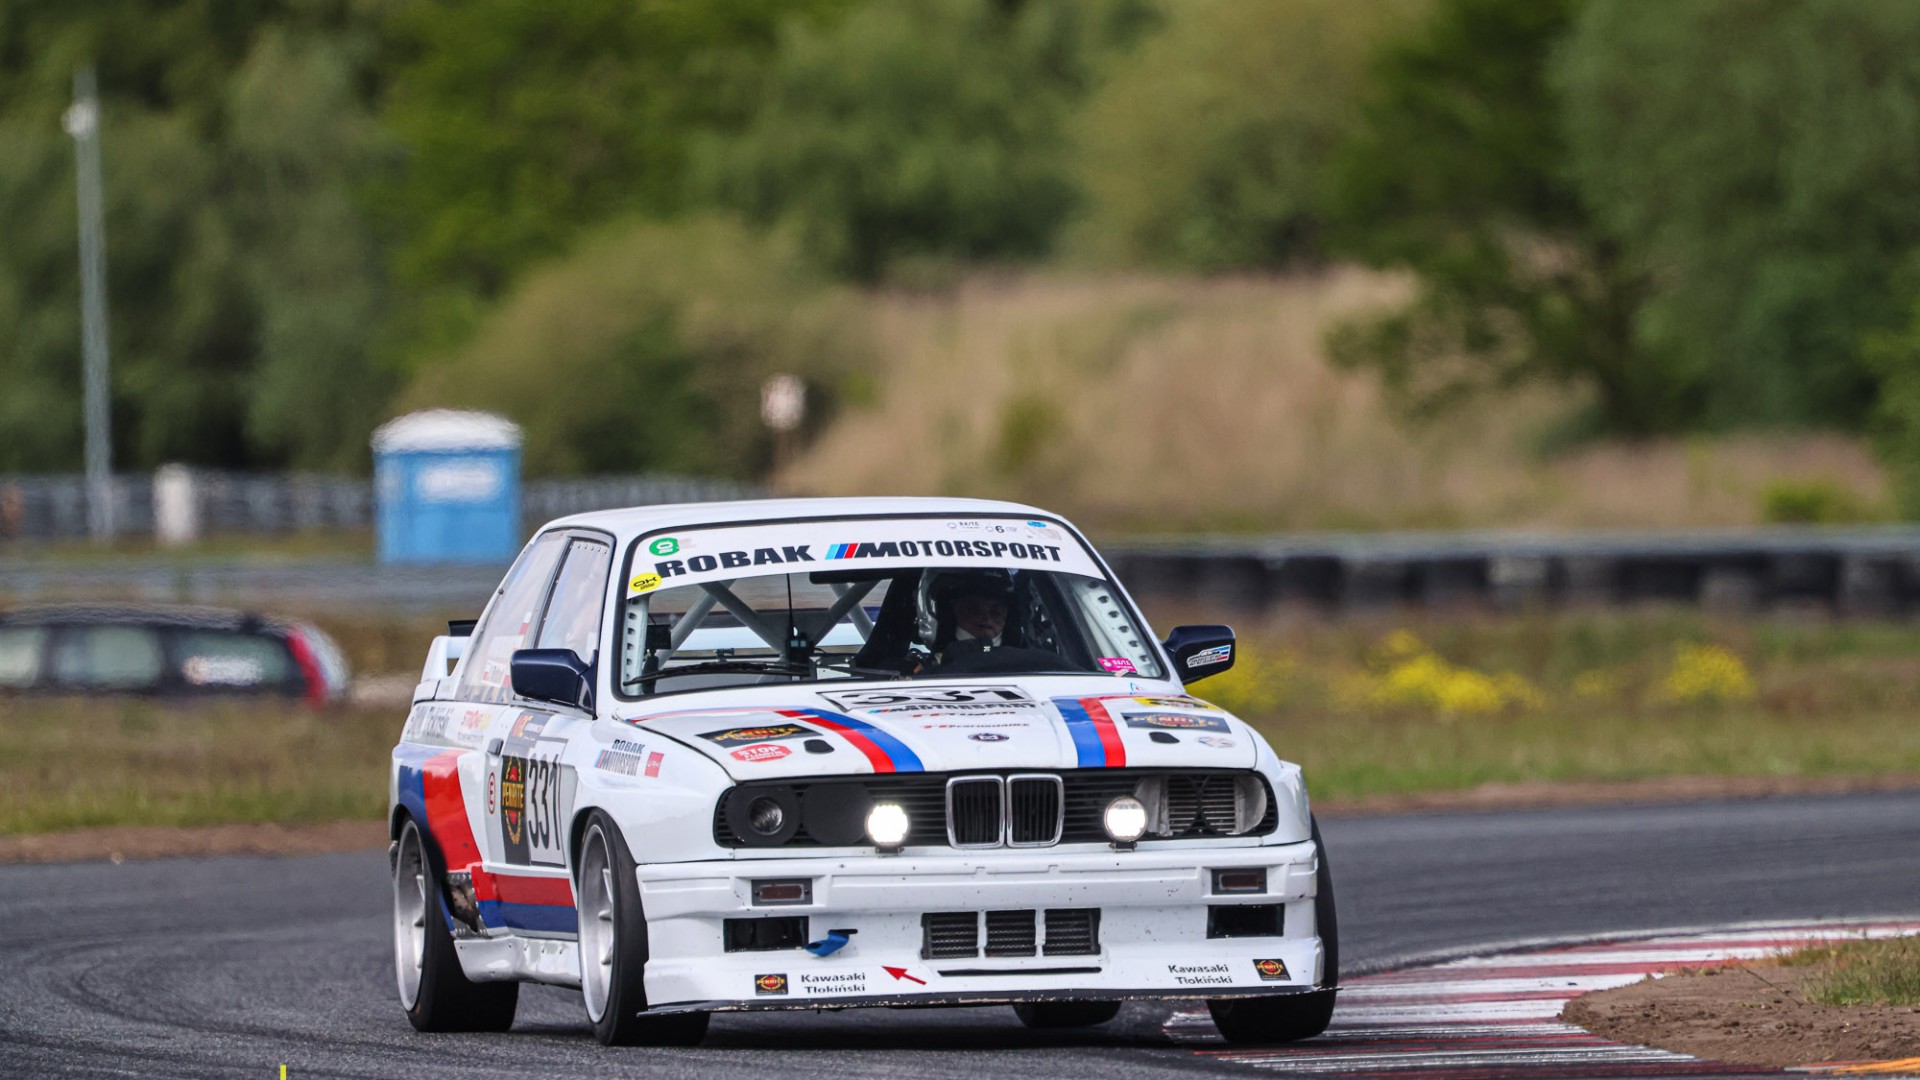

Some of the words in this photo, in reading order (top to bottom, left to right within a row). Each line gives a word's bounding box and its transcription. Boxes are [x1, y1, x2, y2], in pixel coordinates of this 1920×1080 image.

[654, 545, 816, 579] ROBAK
[854, 540, 1061, 562] MOTORSPORT
[841, 688, 1027, 705] 331
[611, 739, 646, 755] ROBAK
[600, 750, 641, 776] MOTORSPORT
[502, 781, 525, 809] PENRITE
[527, 752, 561, 851] 331
[800, 973, 866, 983] Kawasaki
[1167, 964, 1230, 974] Kawasaki
